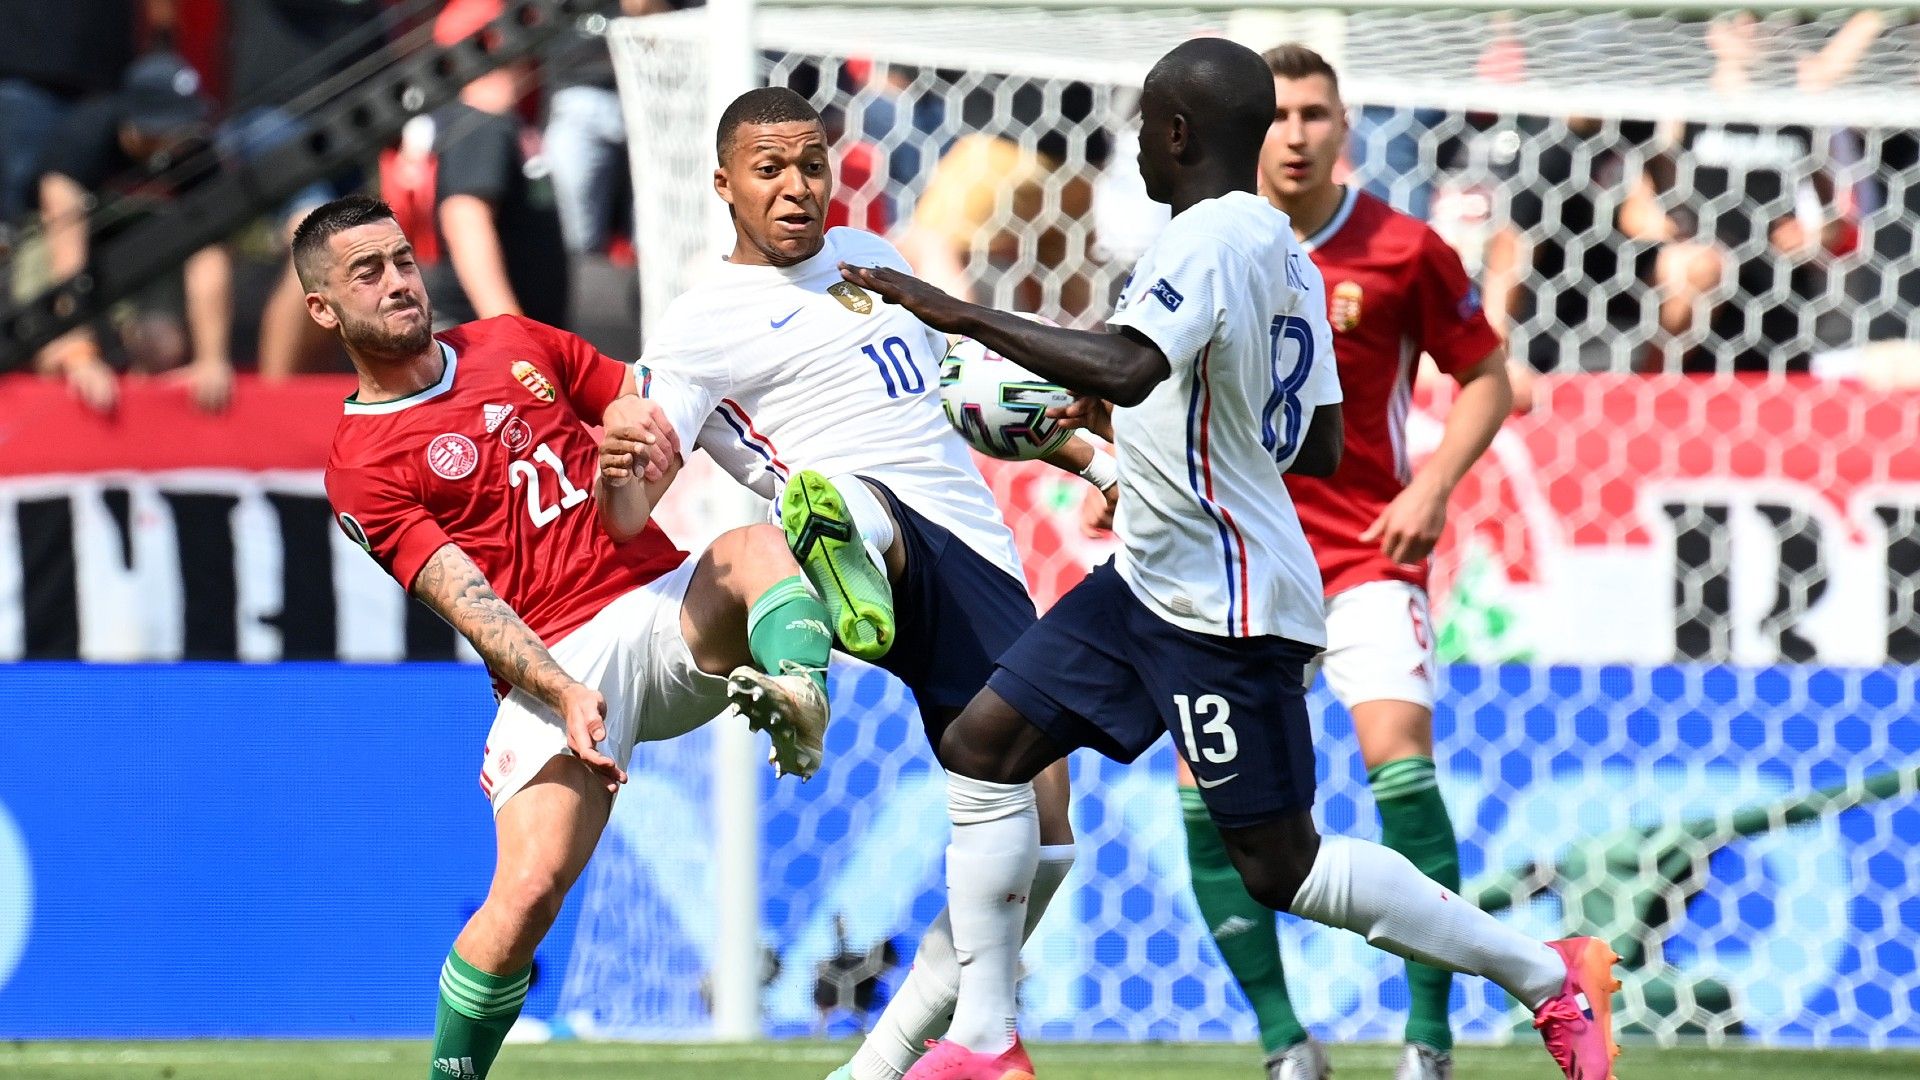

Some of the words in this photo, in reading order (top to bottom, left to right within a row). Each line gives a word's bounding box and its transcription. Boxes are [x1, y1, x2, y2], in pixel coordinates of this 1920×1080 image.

[861, 336, 926, 399] 10
[486, 403, 515, 434] adidas
[508, 442, 589, 529] 21
[1173, 693, 1239, 764] 13
[433, 1059, 480, 1080] adidas
